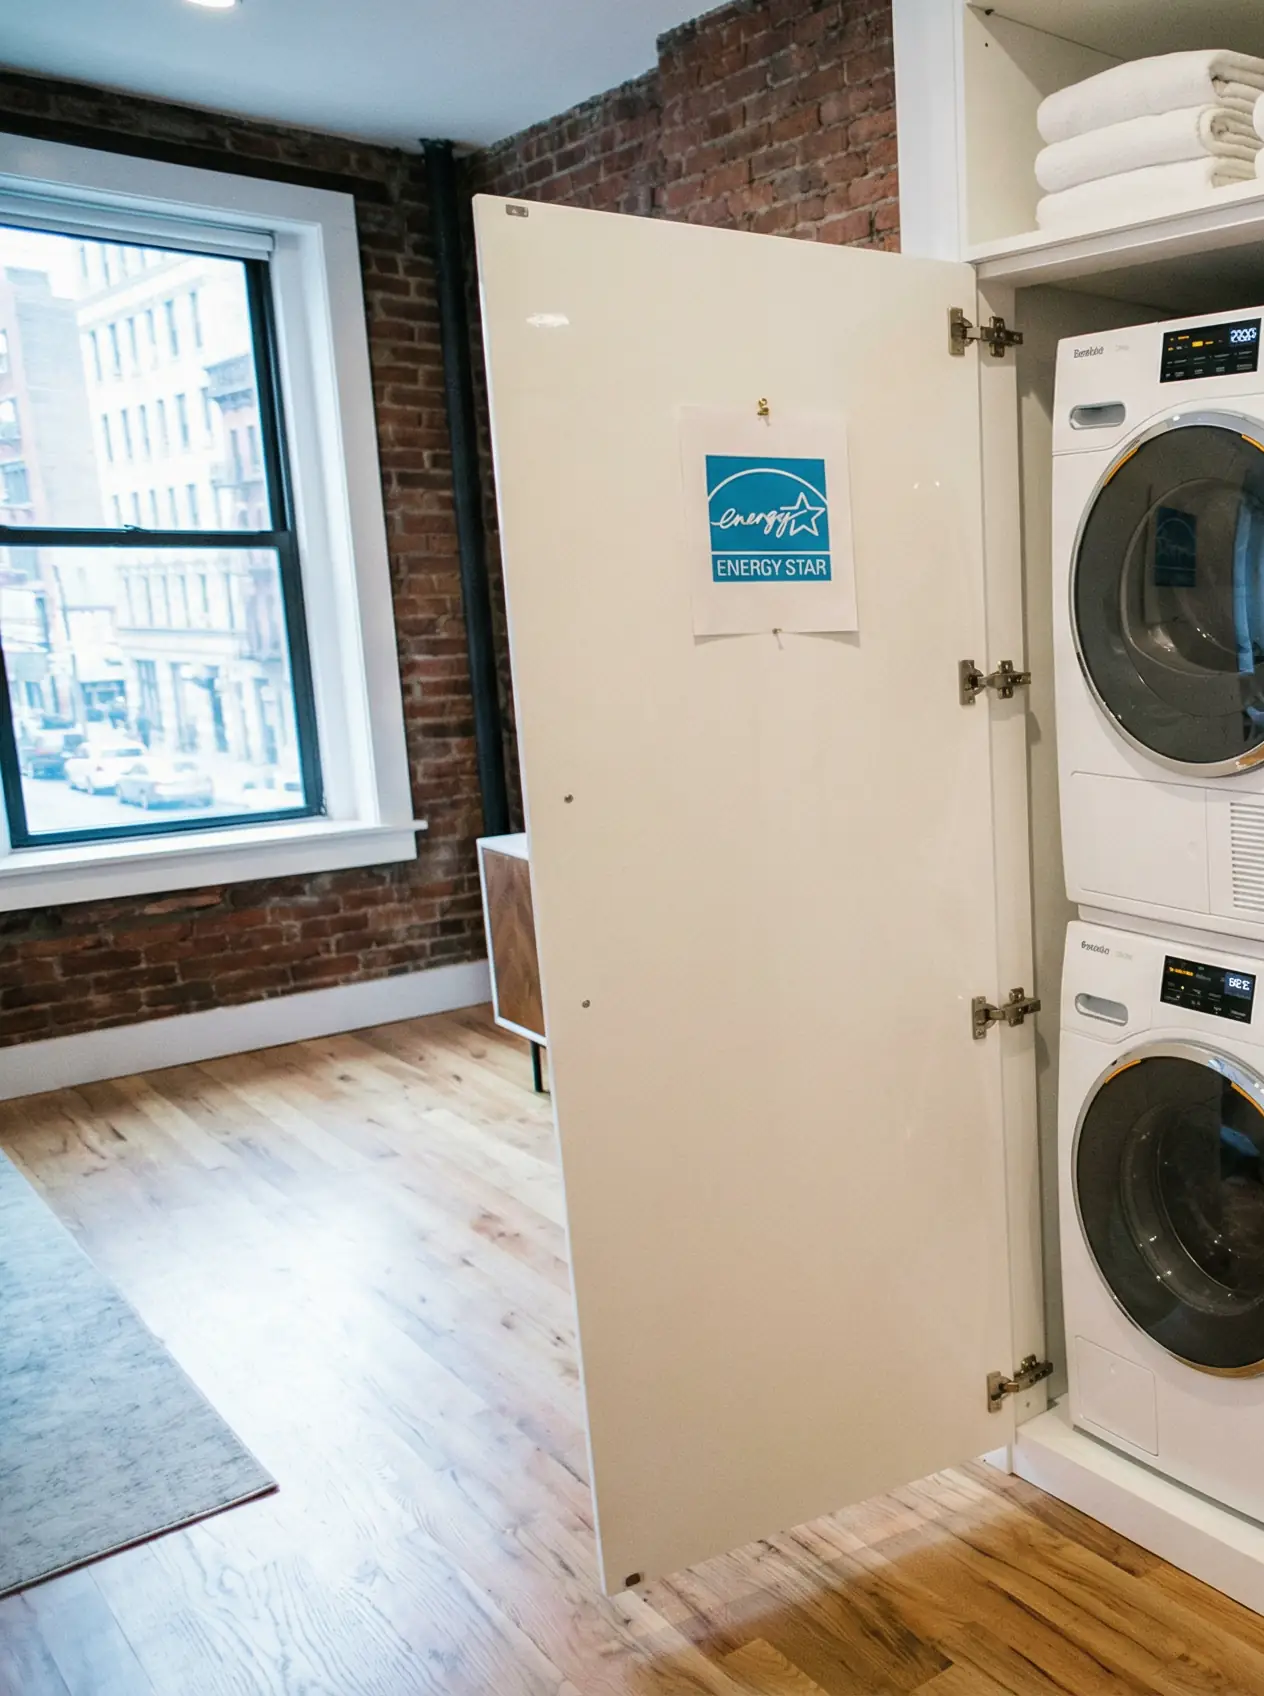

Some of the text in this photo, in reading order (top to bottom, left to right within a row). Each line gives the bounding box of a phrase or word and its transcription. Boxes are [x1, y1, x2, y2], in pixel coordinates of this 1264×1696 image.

[711, 508, 804, 538] energy
[717, 559, 827, 576] ENERGY STAR
